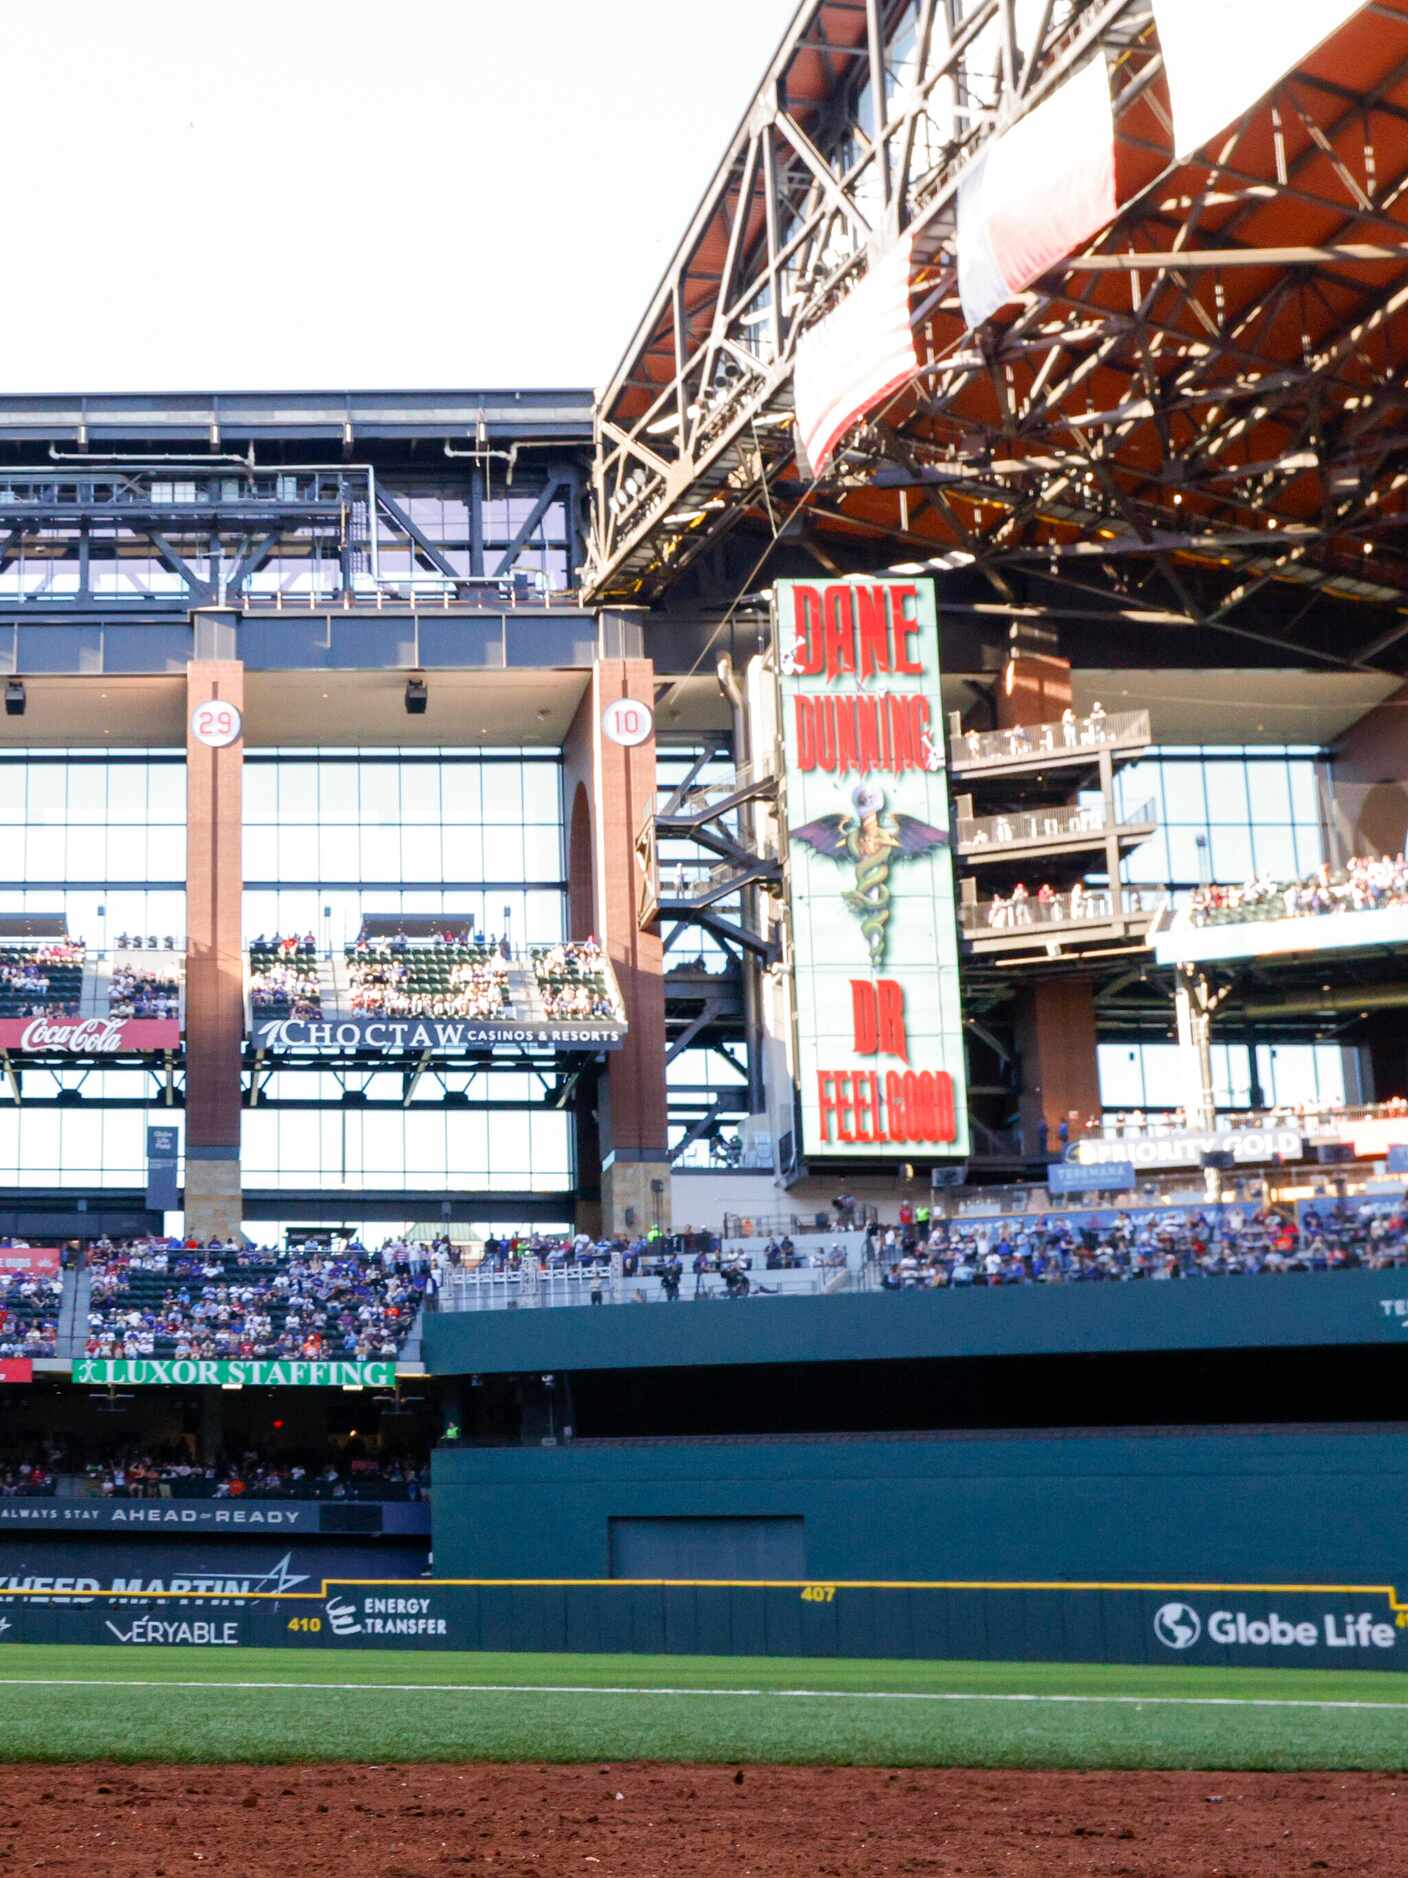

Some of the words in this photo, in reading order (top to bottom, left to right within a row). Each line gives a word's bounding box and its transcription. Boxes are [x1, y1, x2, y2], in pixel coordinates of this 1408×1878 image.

[792, 584, 923, 684] DANE
[198, 710, 233, 735] 29
[614, 709, 640, 733] 10
[795, 694, 936, 778] DUNNING
[279, 1019, 465, 1047] CHOCTAW
[467, 1030, 534, 1042] CASINOS
[537, 1030, 549, 1042] &
[551, 1031, 620, 1043] RESORTS
[850, 979, 910, 1065] DR
[1381, 1300, 1408, 1316] TE
[103, 1361, 219, 1384] LUXOR
[228, 1362, 387, 1386] STAFFING
[1, 1509, 57, 1519] ALWAYS
[64, 1510, 99, 1519] STAY
[111, 1509, 197, 1522] AHEAD
[215, 1510, 300, 1523] READY
[109, 1578, 250, 1606] MARTIN
[800, 1586, 836, 1602] 407
[364, 1598, 431, 1615] ENERGY
[288, 1618, 321, 1632] 410
[365, 1618, 447, 1635] TRANSFER
[1208, 1609, 1319, 1648] Globe
[1325, 1611, 1396, 1649] Life
